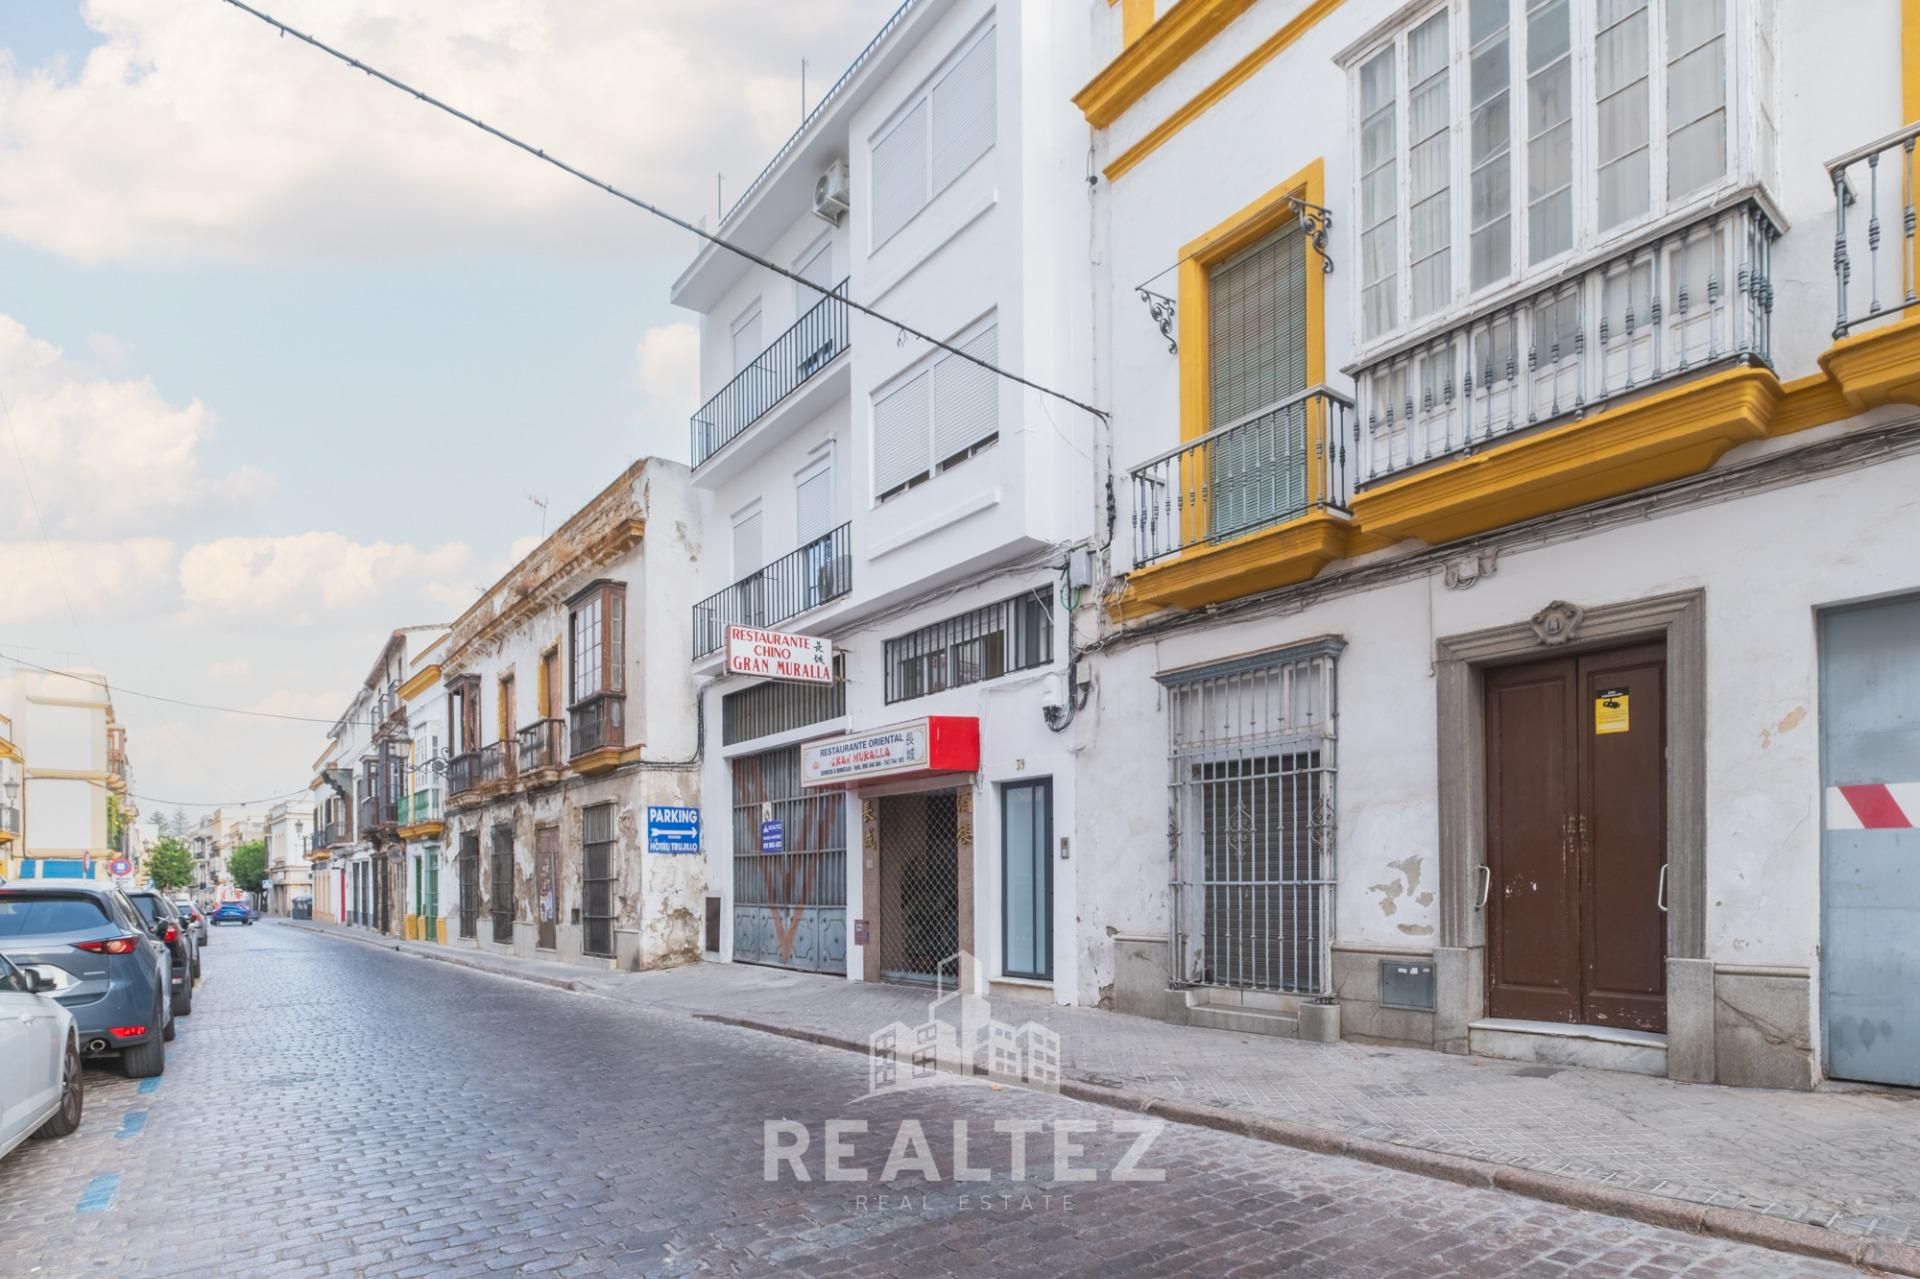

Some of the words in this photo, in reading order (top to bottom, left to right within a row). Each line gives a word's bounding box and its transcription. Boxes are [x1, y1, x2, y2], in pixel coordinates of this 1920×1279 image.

[732, 627, 811, 650] RESTAURANTE
[753, 645, 792, 660] CHINO
[733, 656, 769, 673] GRAN
[776, 659, 831, 680] MURALLA
[820, 740, 868, 758] RESTAURANTE
[868, 733, 904, 748] ORIENTAL
[852, 746, 891, 763] MURALLA
[650, 808, 698, 824] PARKING
[671, 842, 698, 851] TRUJILLO
